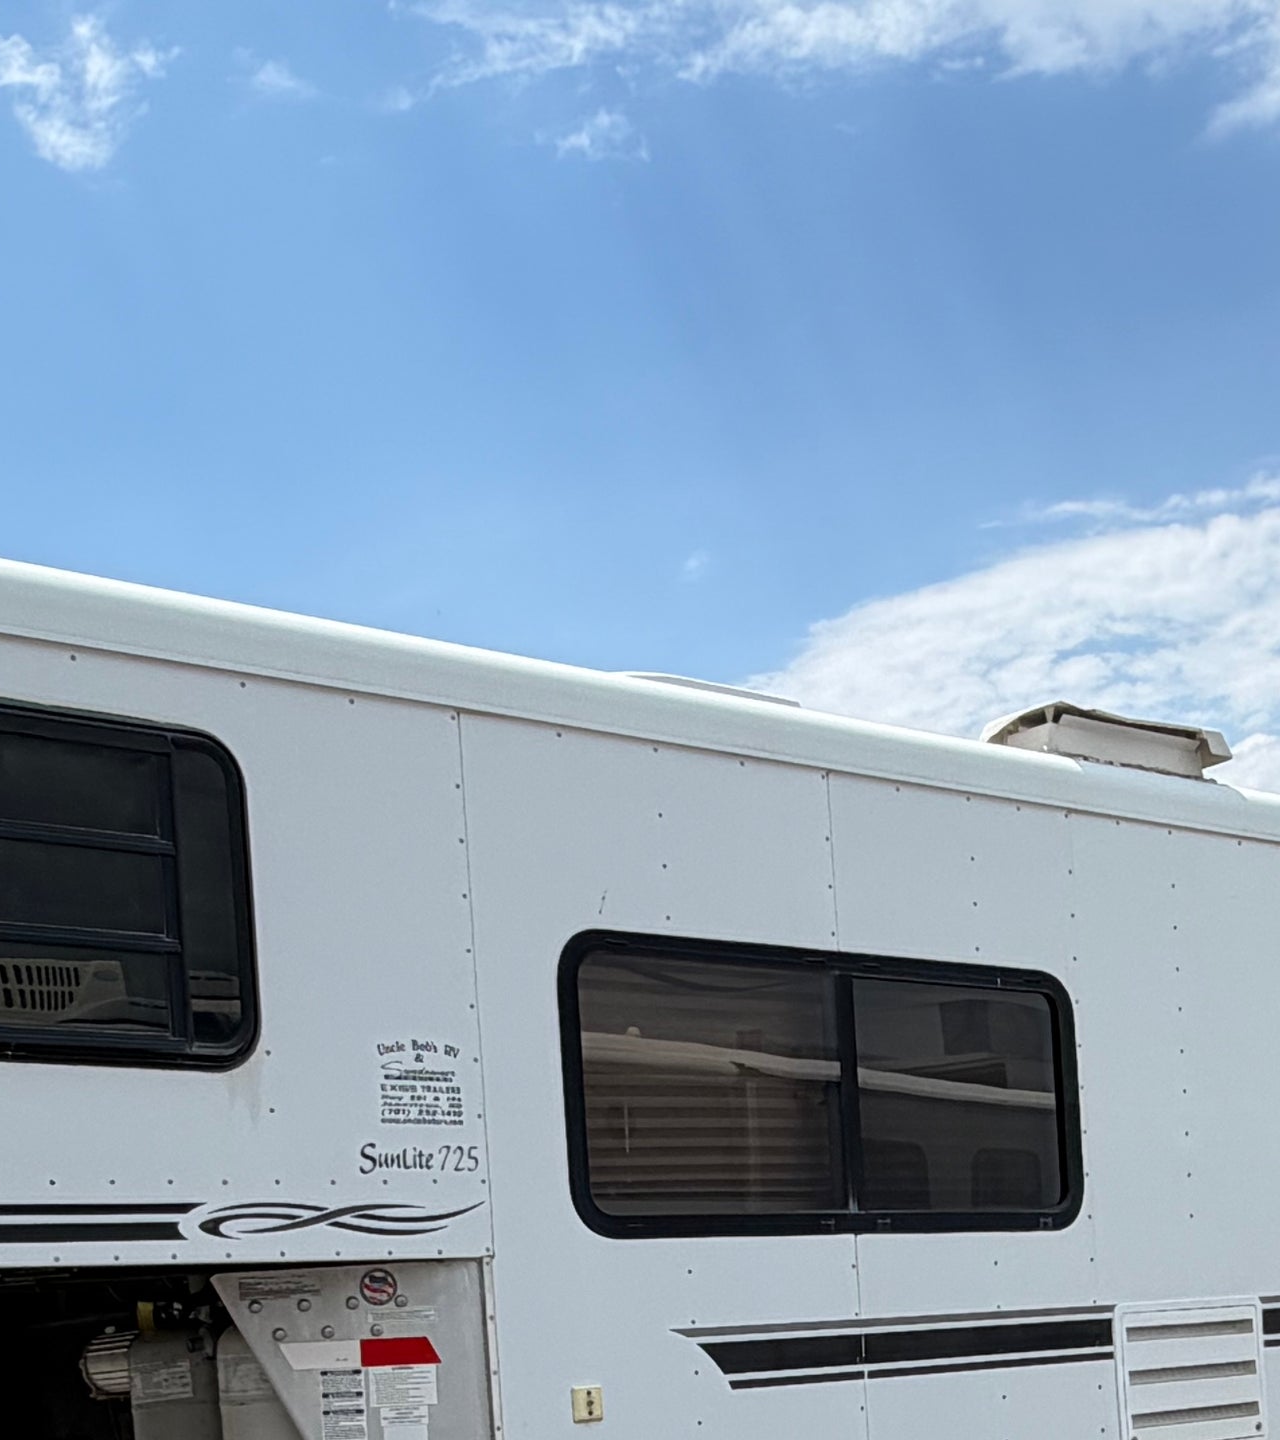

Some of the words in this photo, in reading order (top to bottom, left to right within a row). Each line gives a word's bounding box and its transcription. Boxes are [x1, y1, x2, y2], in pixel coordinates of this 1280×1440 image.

[377, 1041, 406, 1056] Uncle
[411, 1039, 438, 1053] Bob's
[444, 1044, 460, 1058] RV
[415, 1053, 424, 1063] &
[359, 1142, 434, 1175] SunLite
[438, 1145, 479, 1172] 725
